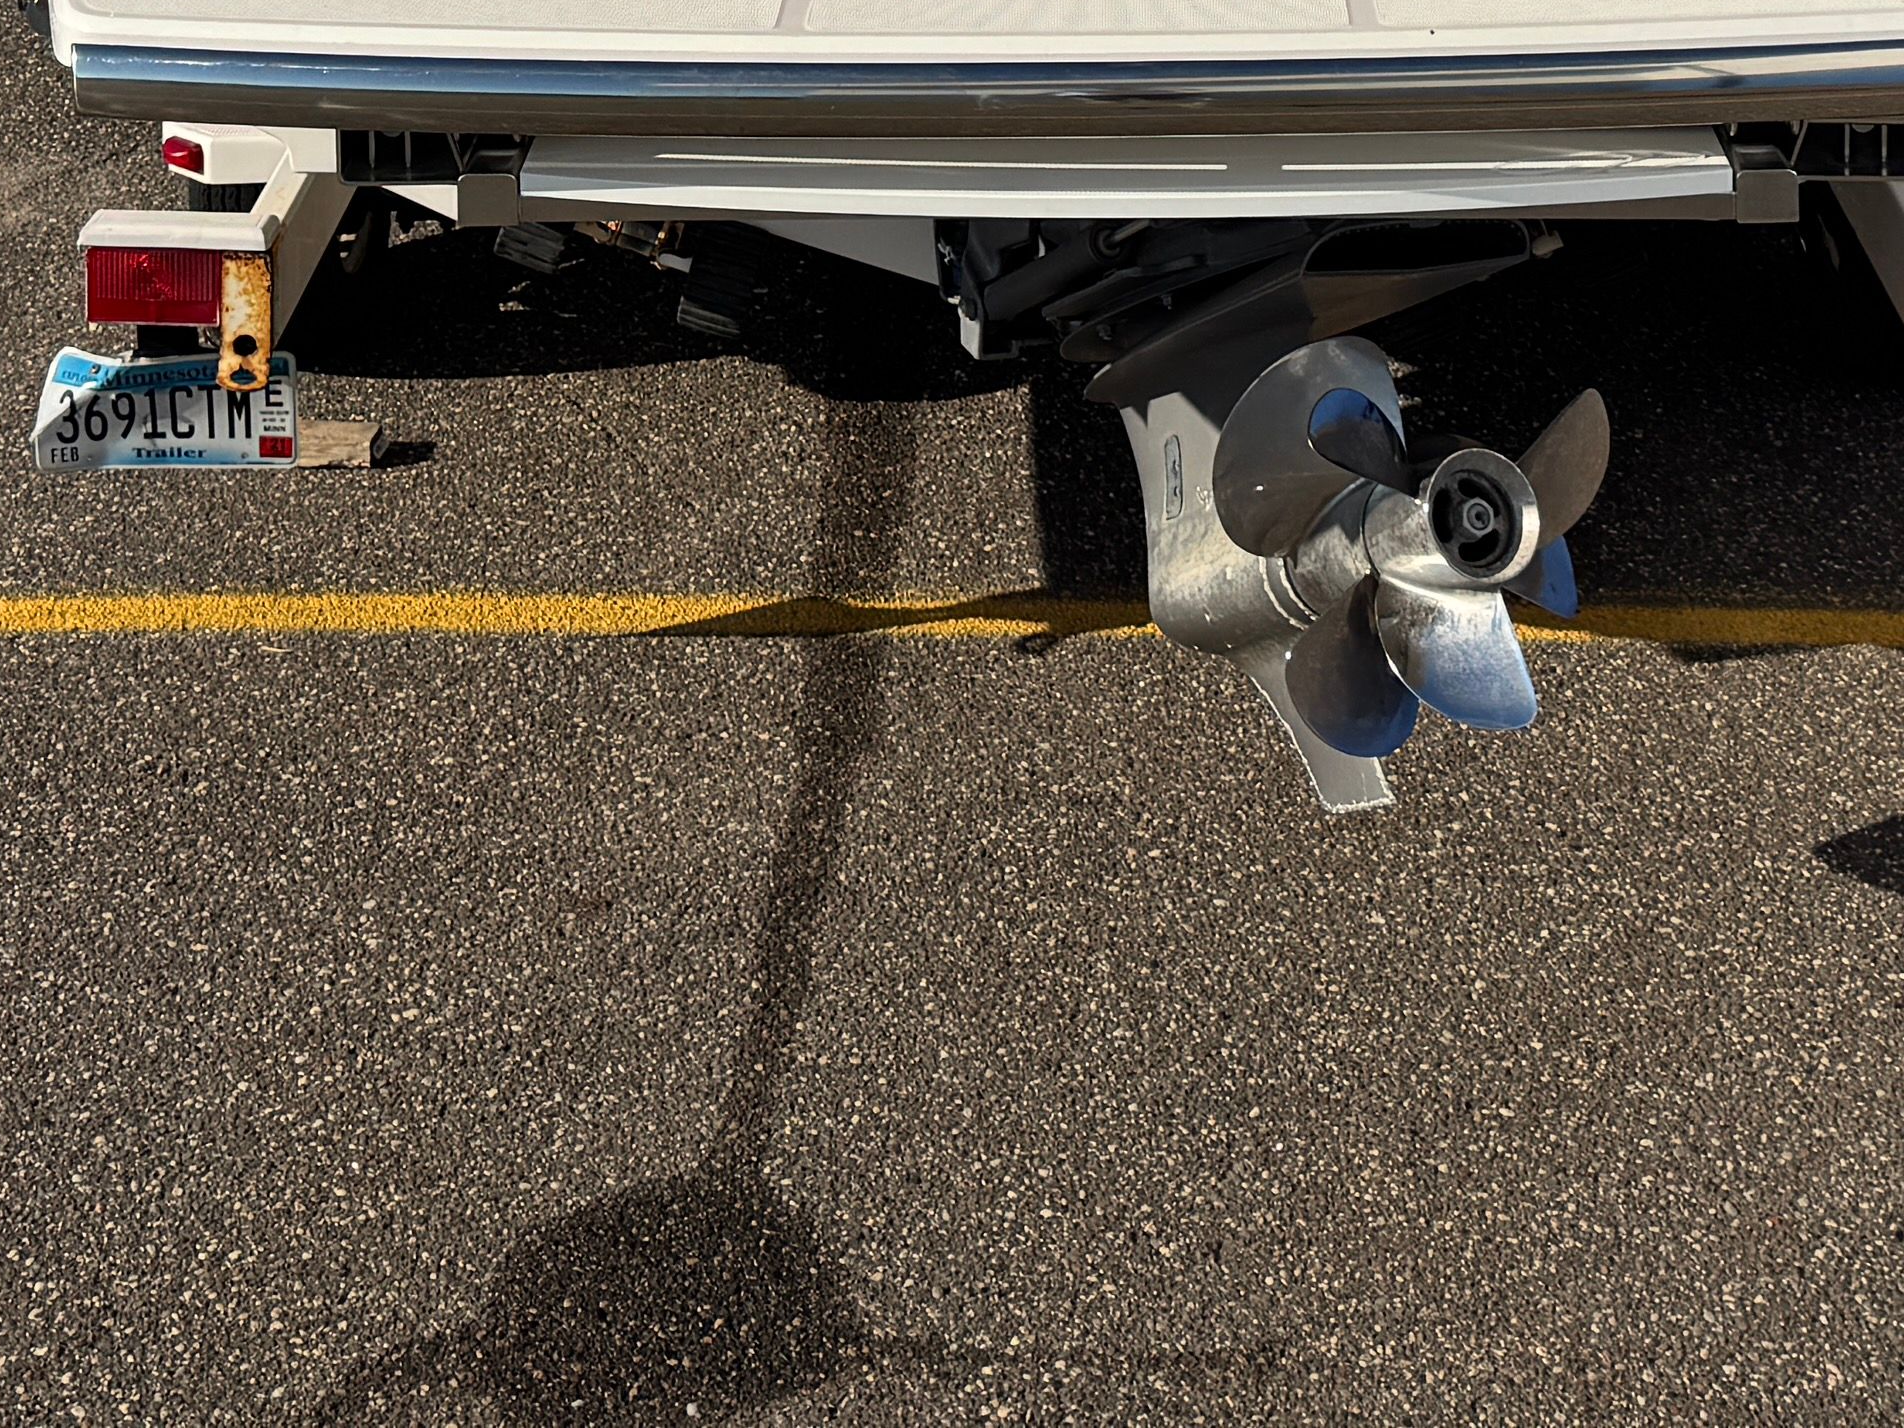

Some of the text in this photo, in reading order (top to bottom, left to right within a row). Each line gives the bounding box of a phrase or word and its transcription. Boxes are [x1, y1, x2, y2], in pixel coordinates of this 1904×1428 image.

[56, 384, 252, 444] 3691CTM
[50, 446, 80, 464] FEB
[132, 447, 208, 460] Trailer
